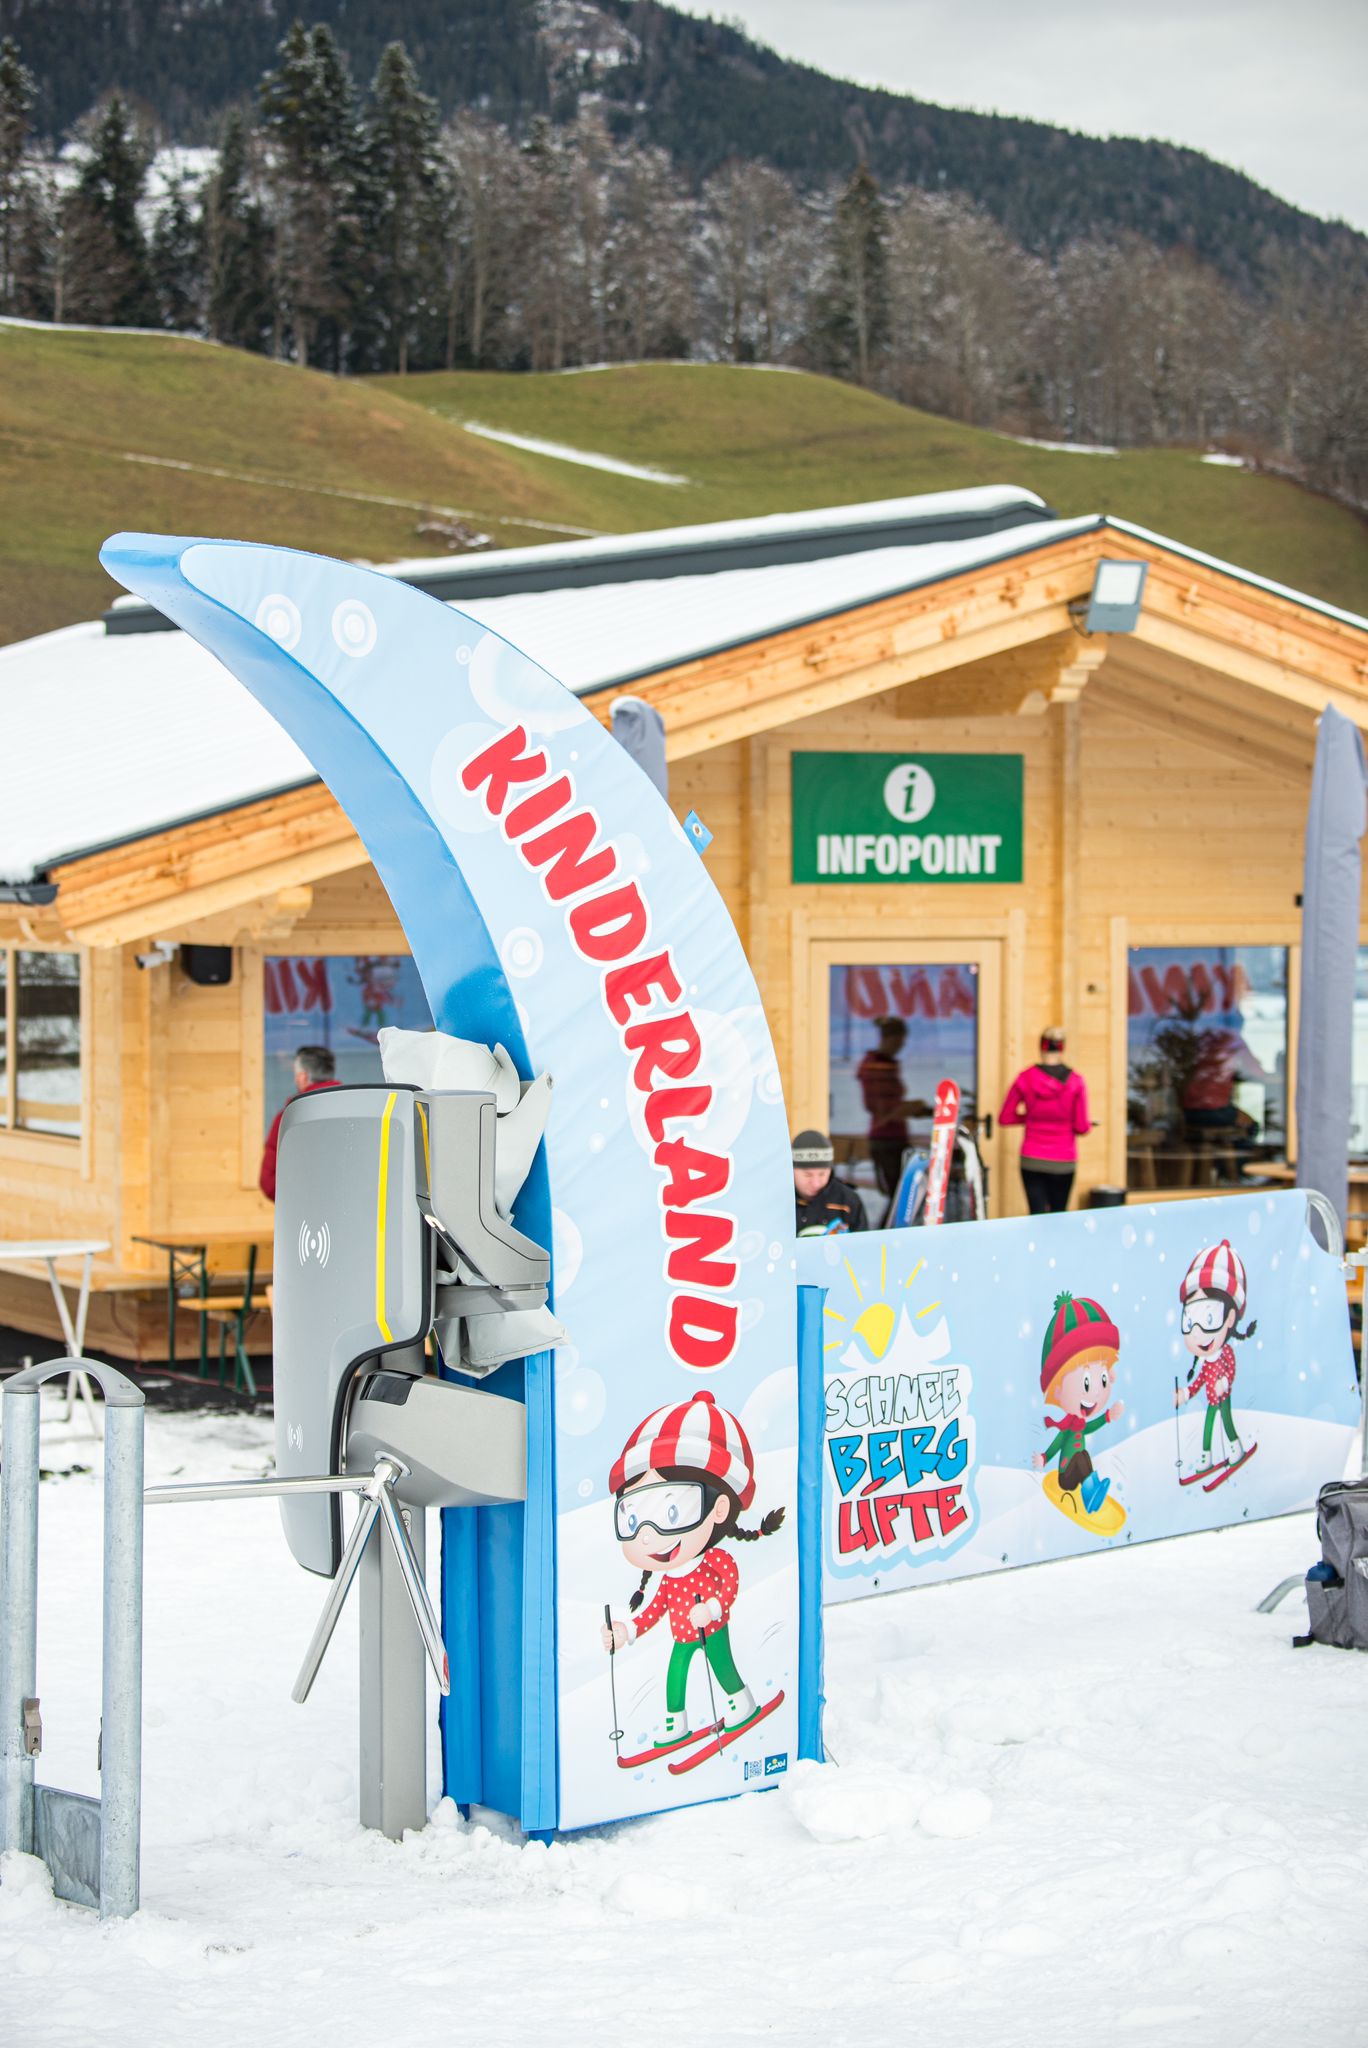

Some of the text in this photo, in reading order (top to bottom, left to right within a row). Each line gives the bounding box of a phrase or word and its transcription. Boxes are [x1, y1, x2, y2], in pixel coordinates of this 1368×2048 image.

[817, 834, 1002, 875] INFOPOINT
[462, 726, 737, 1366] KINDERLAND
[824, 1369, 962, 1432] SCHNEE
[828, 1417, 968, 1497] BERG
[838, 1476, 968, 1554] LIFTE
